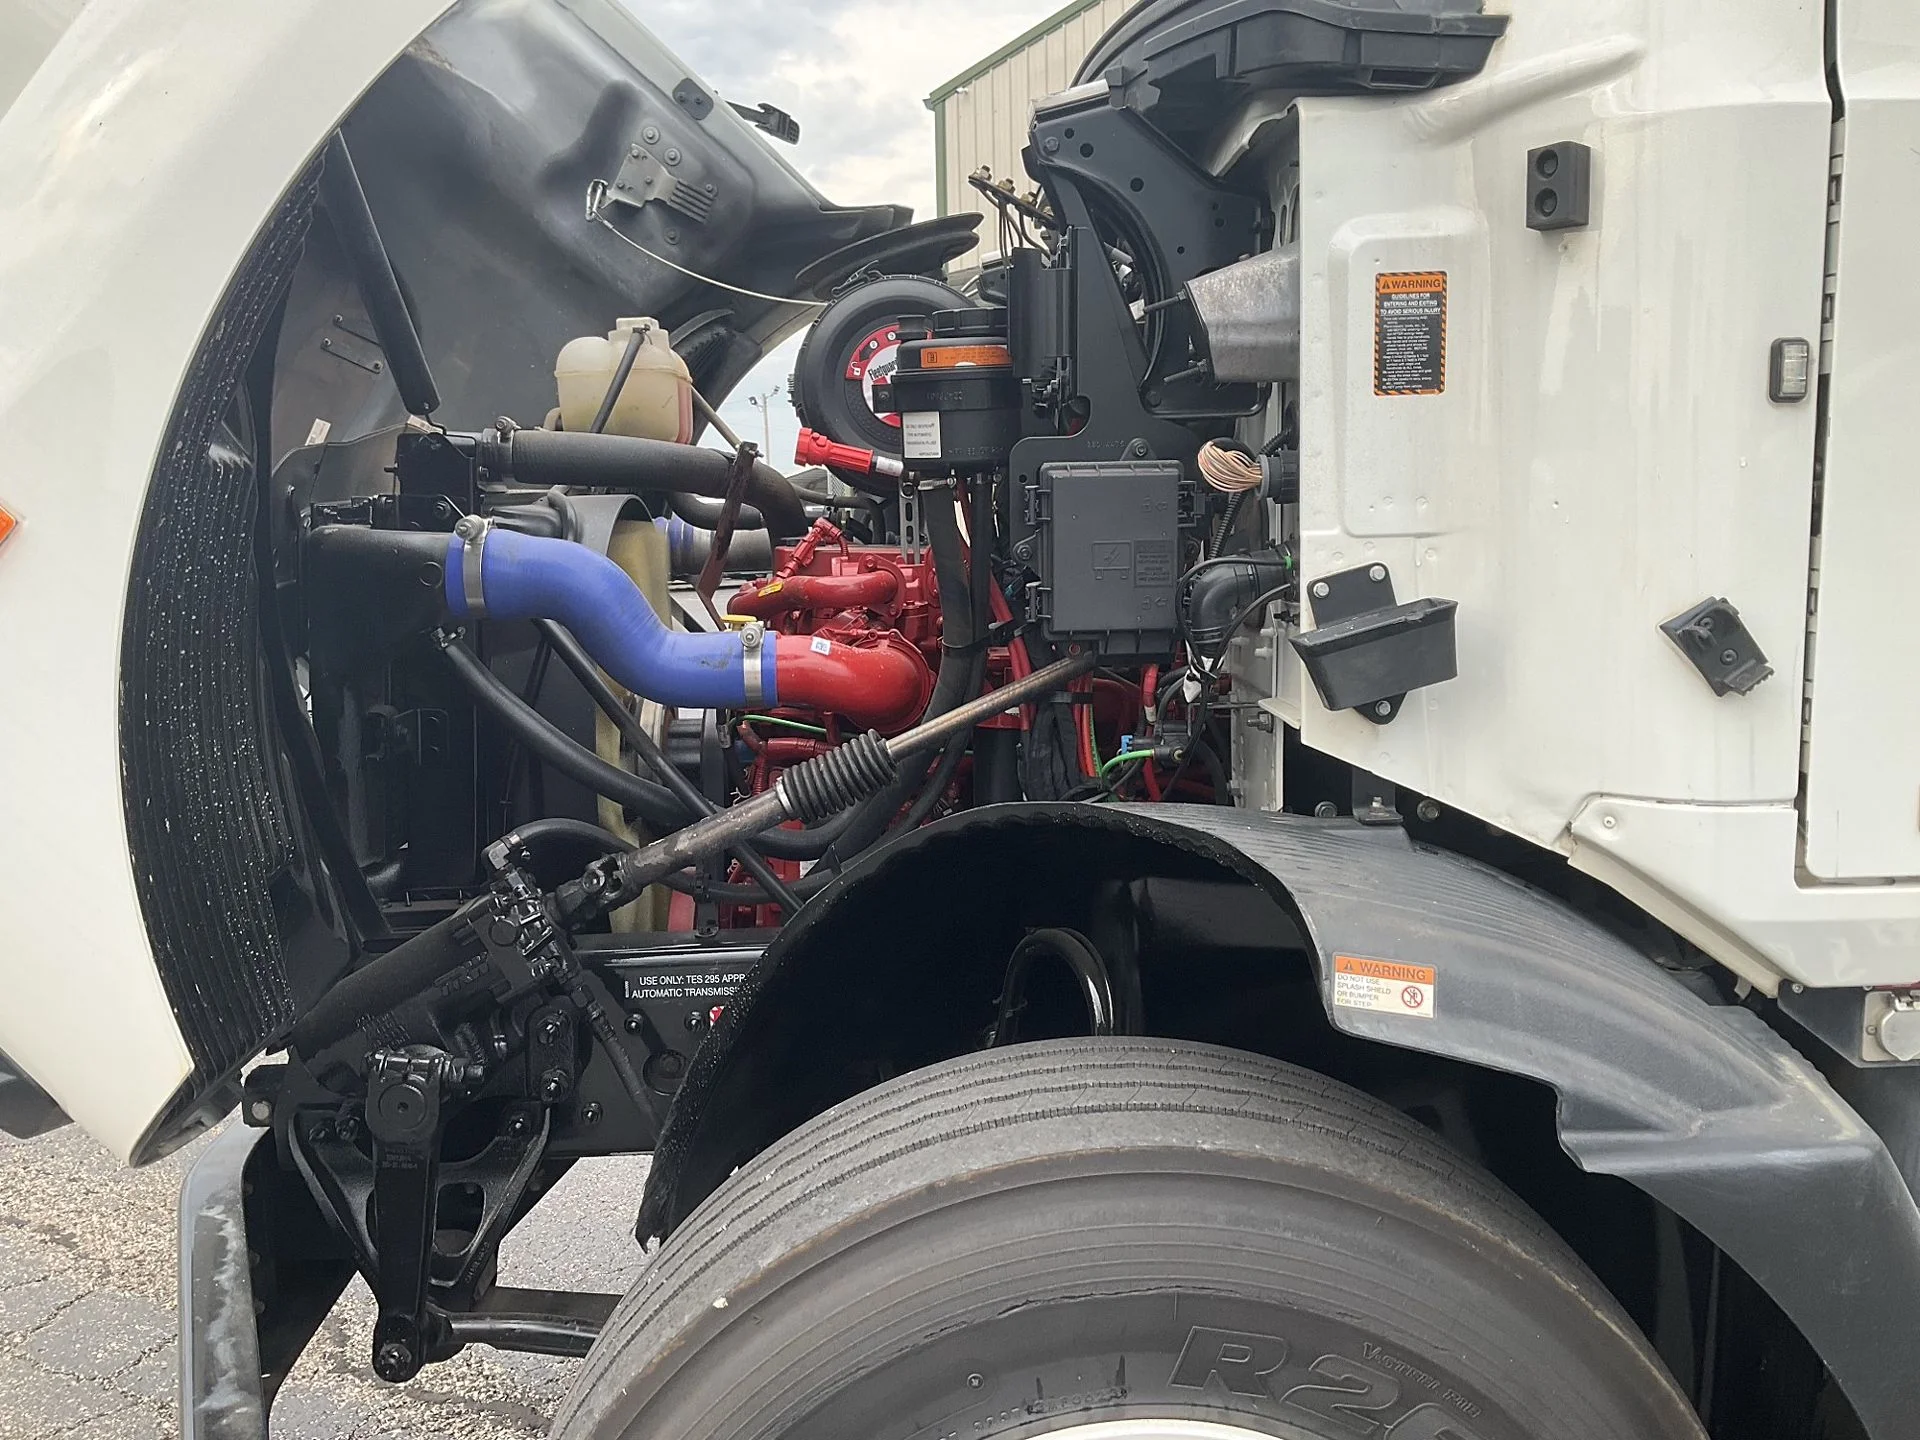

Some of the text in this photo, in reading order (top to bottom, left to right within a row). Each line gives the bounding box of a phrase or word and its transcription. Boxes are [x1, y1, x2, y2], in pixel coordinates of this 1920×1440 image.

[1391, 279, 1441, 290] WARNING
[1360, 961, 1426, 981] WARNING
[640, 976, 658, 986] USE
[659, 975, 685, 985] ONLY:
[686, 974, 703, 984] TES
[705, 974, 720, 984] 295
[1349, 975, 1364, 983] NOT
[1366, 977, 1380, 985] USE
[632, 988, 683, 999] AUTOMATIC
[1337, 982, 1391, 995] SPLASH SHIELD
